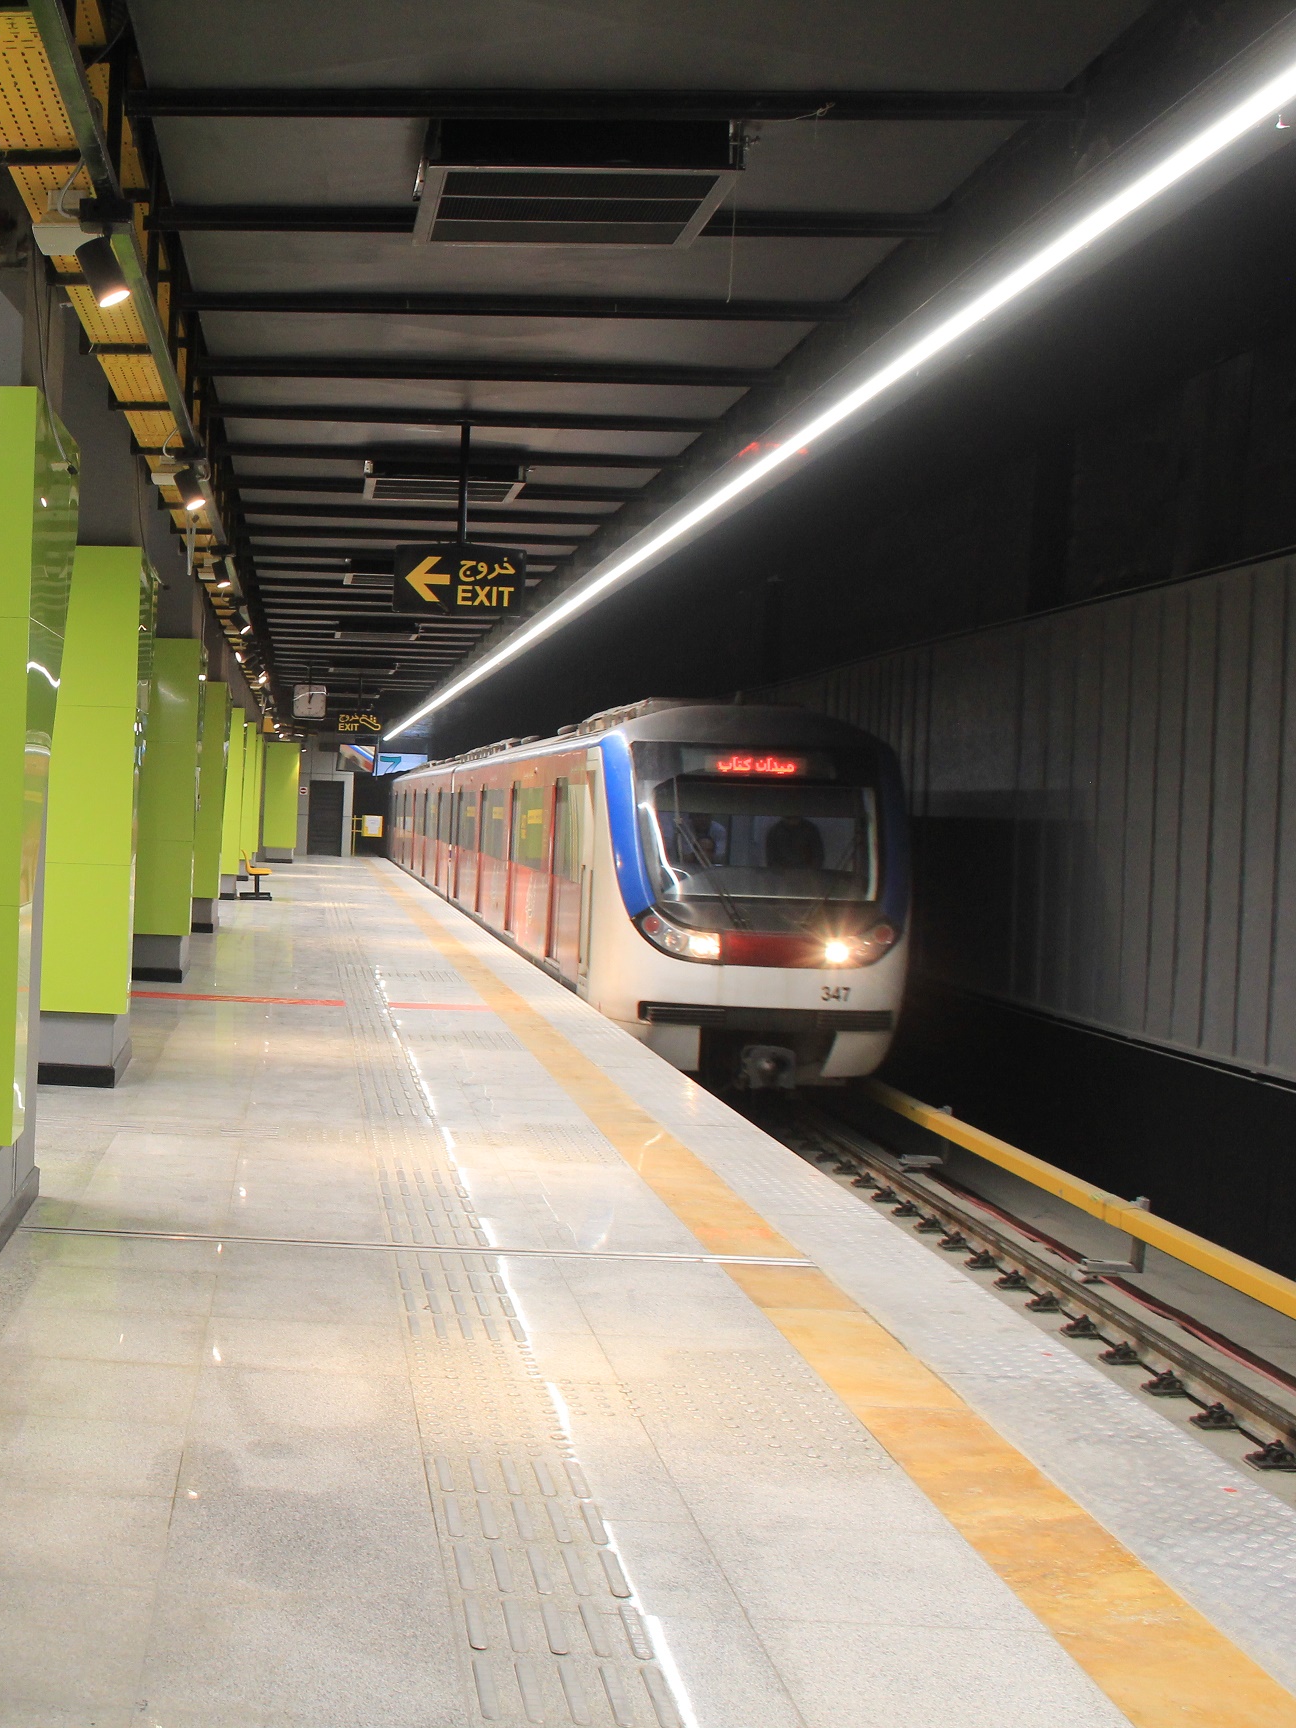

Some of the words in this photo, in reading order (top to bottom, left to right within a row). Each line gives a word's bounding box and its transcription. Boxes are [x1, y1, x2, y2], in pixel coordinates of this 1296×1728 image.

[458, 556, 516, 582] خروج
[456, 585, 515, 607] EXIT
[338, 713, 360, 723] خروج
[338, 723, 359, 732] EXIT
[718, 756, 753, 773] کتاب
[755, 758, 795, 774] میدان
[821, 986, 851, 1002] 347
